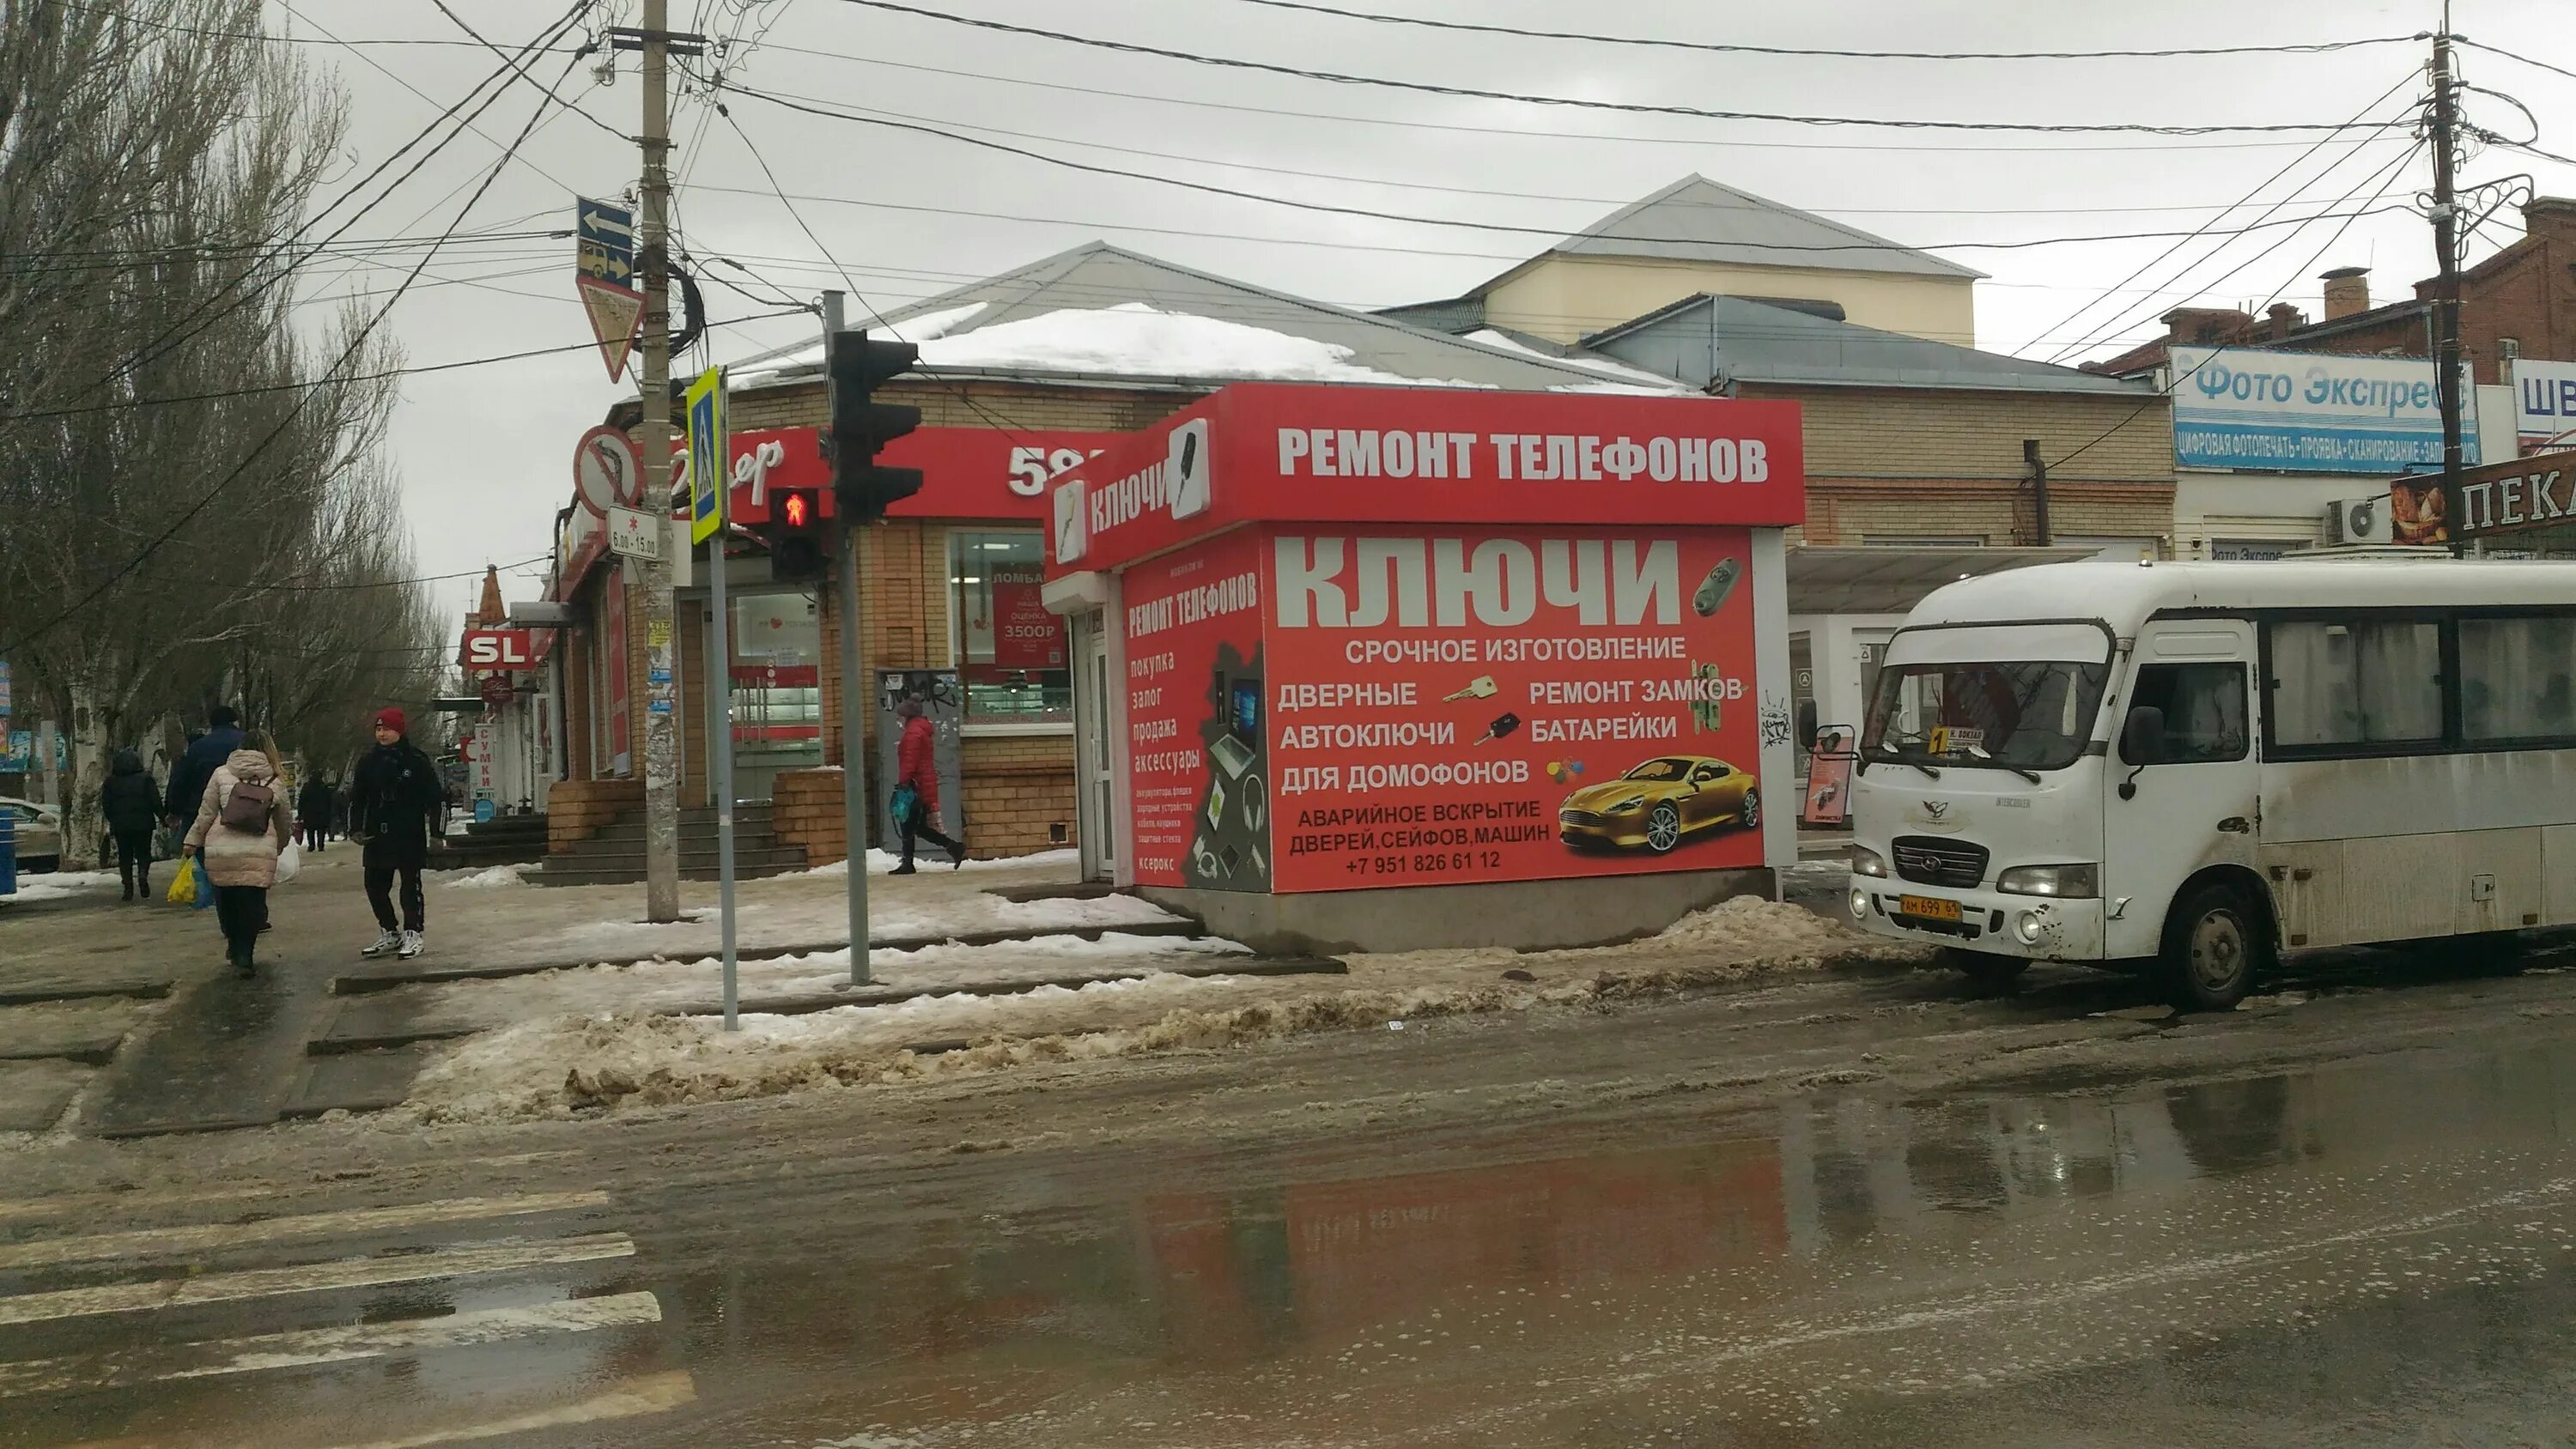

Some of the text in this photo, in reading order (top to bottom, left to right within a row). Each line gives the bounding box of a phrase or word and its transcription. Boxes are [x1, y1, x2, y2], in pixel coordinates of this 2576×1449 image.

[2196, 361, 2467, 418] Фото Экспре
[1278, 427, 1769, 483] РЕМОНТ ТЕЛЕФОНОВ
[2178, 432, 2232, 458] ЦИФРОВАЯ
[2233, 433, 2294, 458] ФОТОПЕЧАТЬ
[2300, 436, 2343, 460] ПРОЯВКА
[2348, 439, 2419, 461] СКАНИРОВАНИЕ
[1091, 457, 1171, 535] КЛЮЧИ
[993, 573, 1044, 584] ЛОМБА
[1275, 537, 1682, 629] КЛЮЧИ
[1128, 572, 1256, 639] РЕМОНТ ТЕЛЕФОНОВ
[470, 636, 525, 664] SL
[1346, 637, 1686, 664] СРОЧНОЕ ИЗГОТОВЛЕНИЕ
[1130, 652, 1175, 681] покупка
[1132, 688, 1163, 709] залог
[1278, 683, 1418, 712] ДВЕРНЫЕ
[1529, 677, 1744, 705] РЕМОНТ ЗАМКОВ
[1133, 718, 1177, 746] продажа
[1280, 721, 1455, 749] АВТОКЛЮЧИ
[1531, 712, 1678, 743] БАТАРЕЙКИ
[1934, 731, 1943, 753] 1
[480, 729, 491, 787] СУМКИ
[1134, 749, 1200, 776] аксессуары
[1281, 760, 1529, 795] ДЛЯ ДОМОФОНОВ
[1297, 800, 1541, 828] АВАРИЙНОЕ ВСКРЫТИЕ
[1139, 858, 1175, 874] ксерокс
[1346, 851, 1501, 875] +7 951 826 61 12
[1921, 900, 1940, 915] 699
